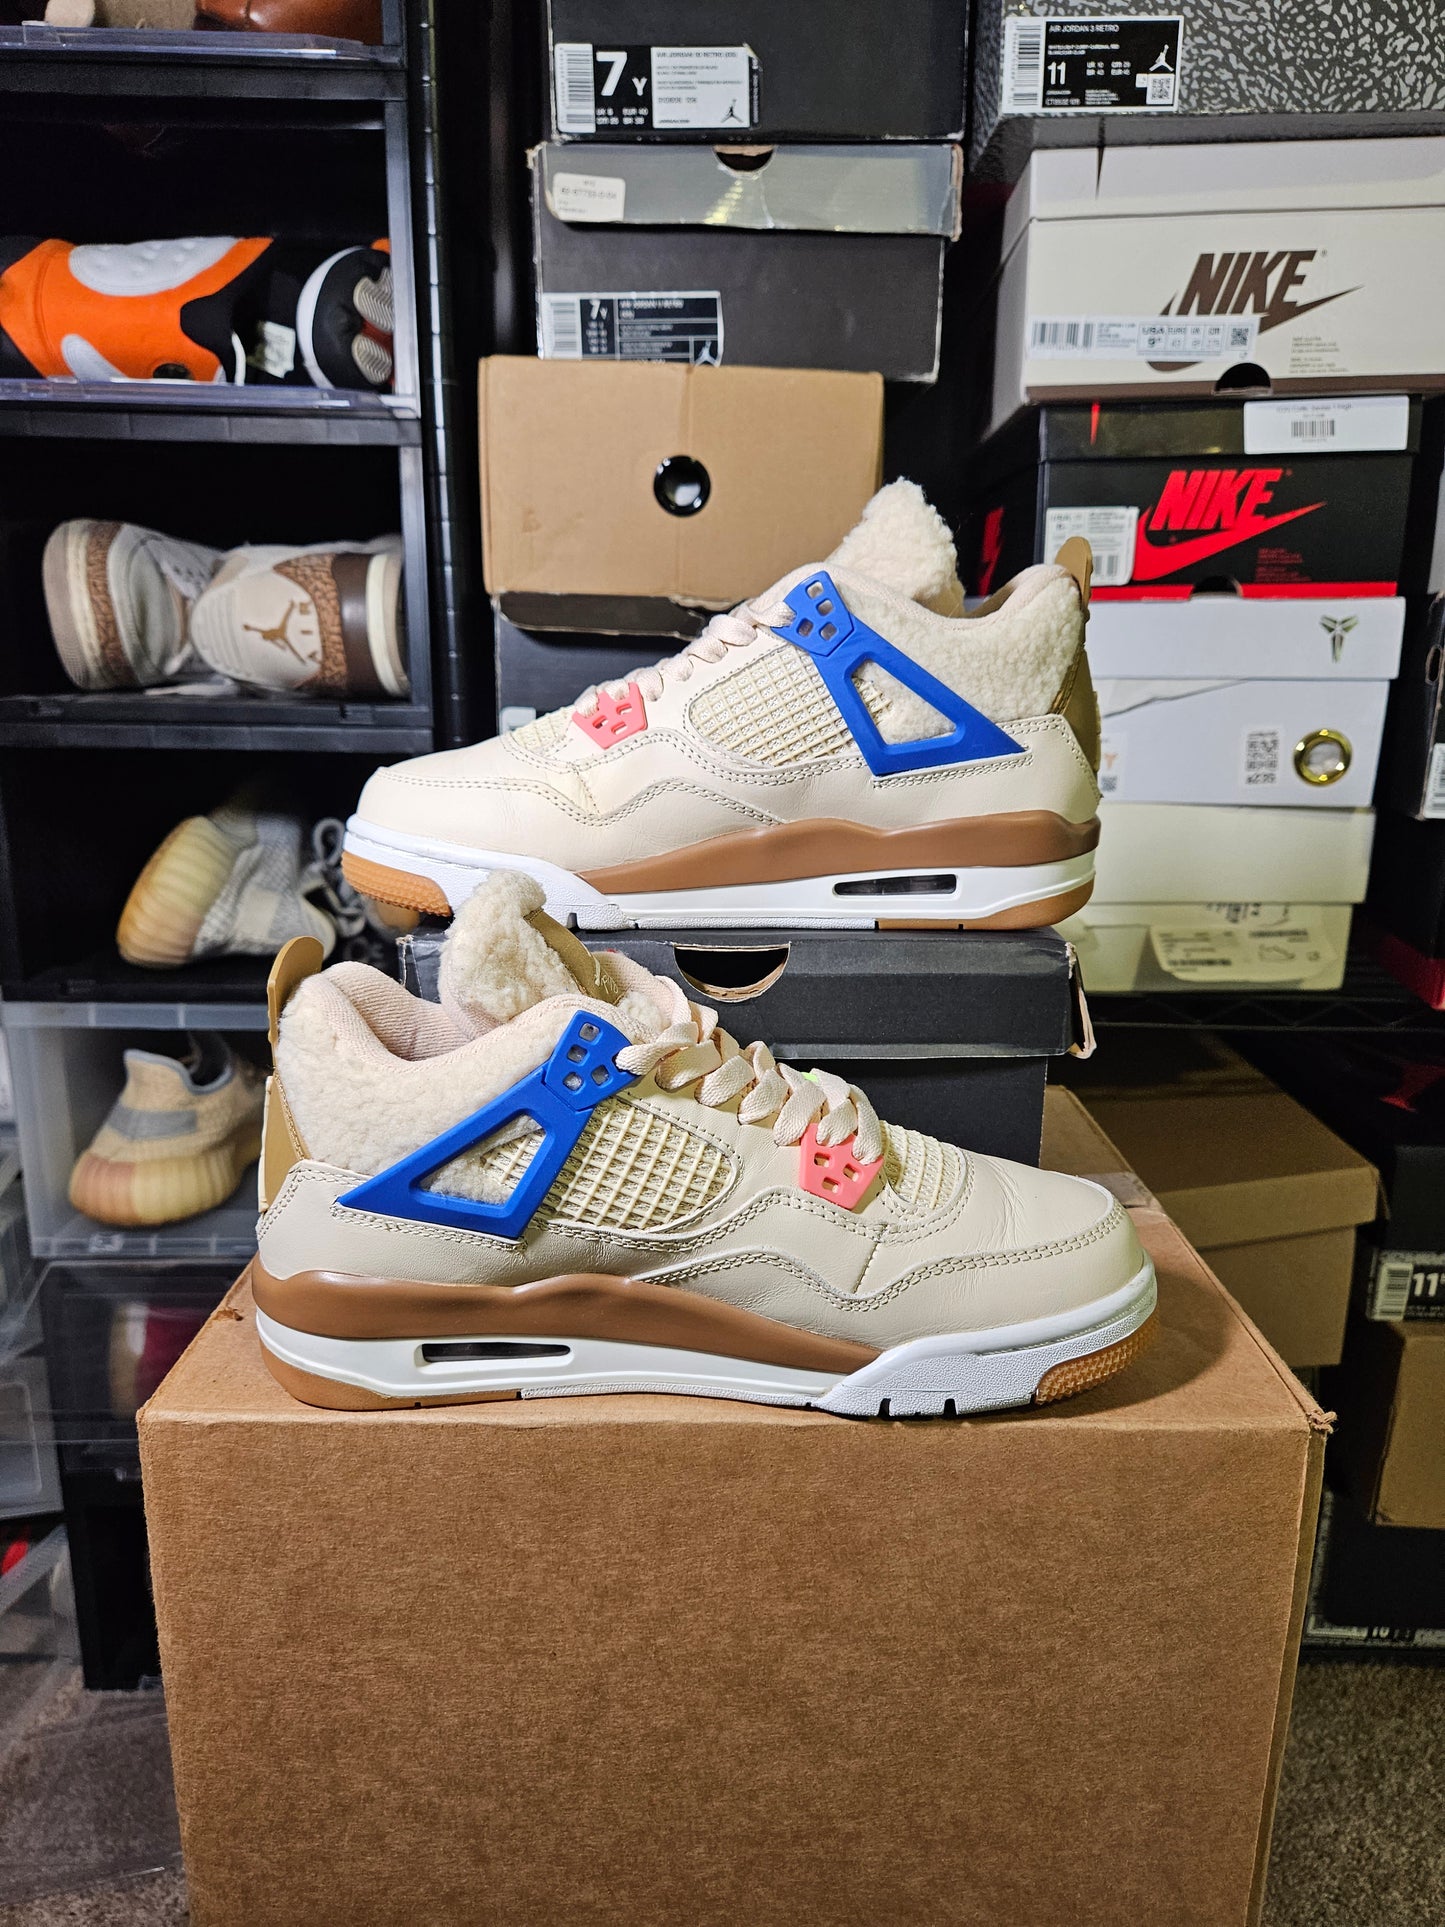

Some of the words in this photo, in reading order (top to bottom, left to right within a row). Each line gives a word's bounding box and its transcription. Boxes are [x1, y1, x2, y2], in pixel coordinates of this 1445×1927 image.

[1049, 24, 1062, 33] AIR
[1062, 24, 1090, 33] JORDAN
[1095, 24, 1120, 33] RETRO
[1047, 61, 1066, 85] 11
[1175, 249, 1318, 316] NIKE
[1148, 468, 1284, 531] NIKE
